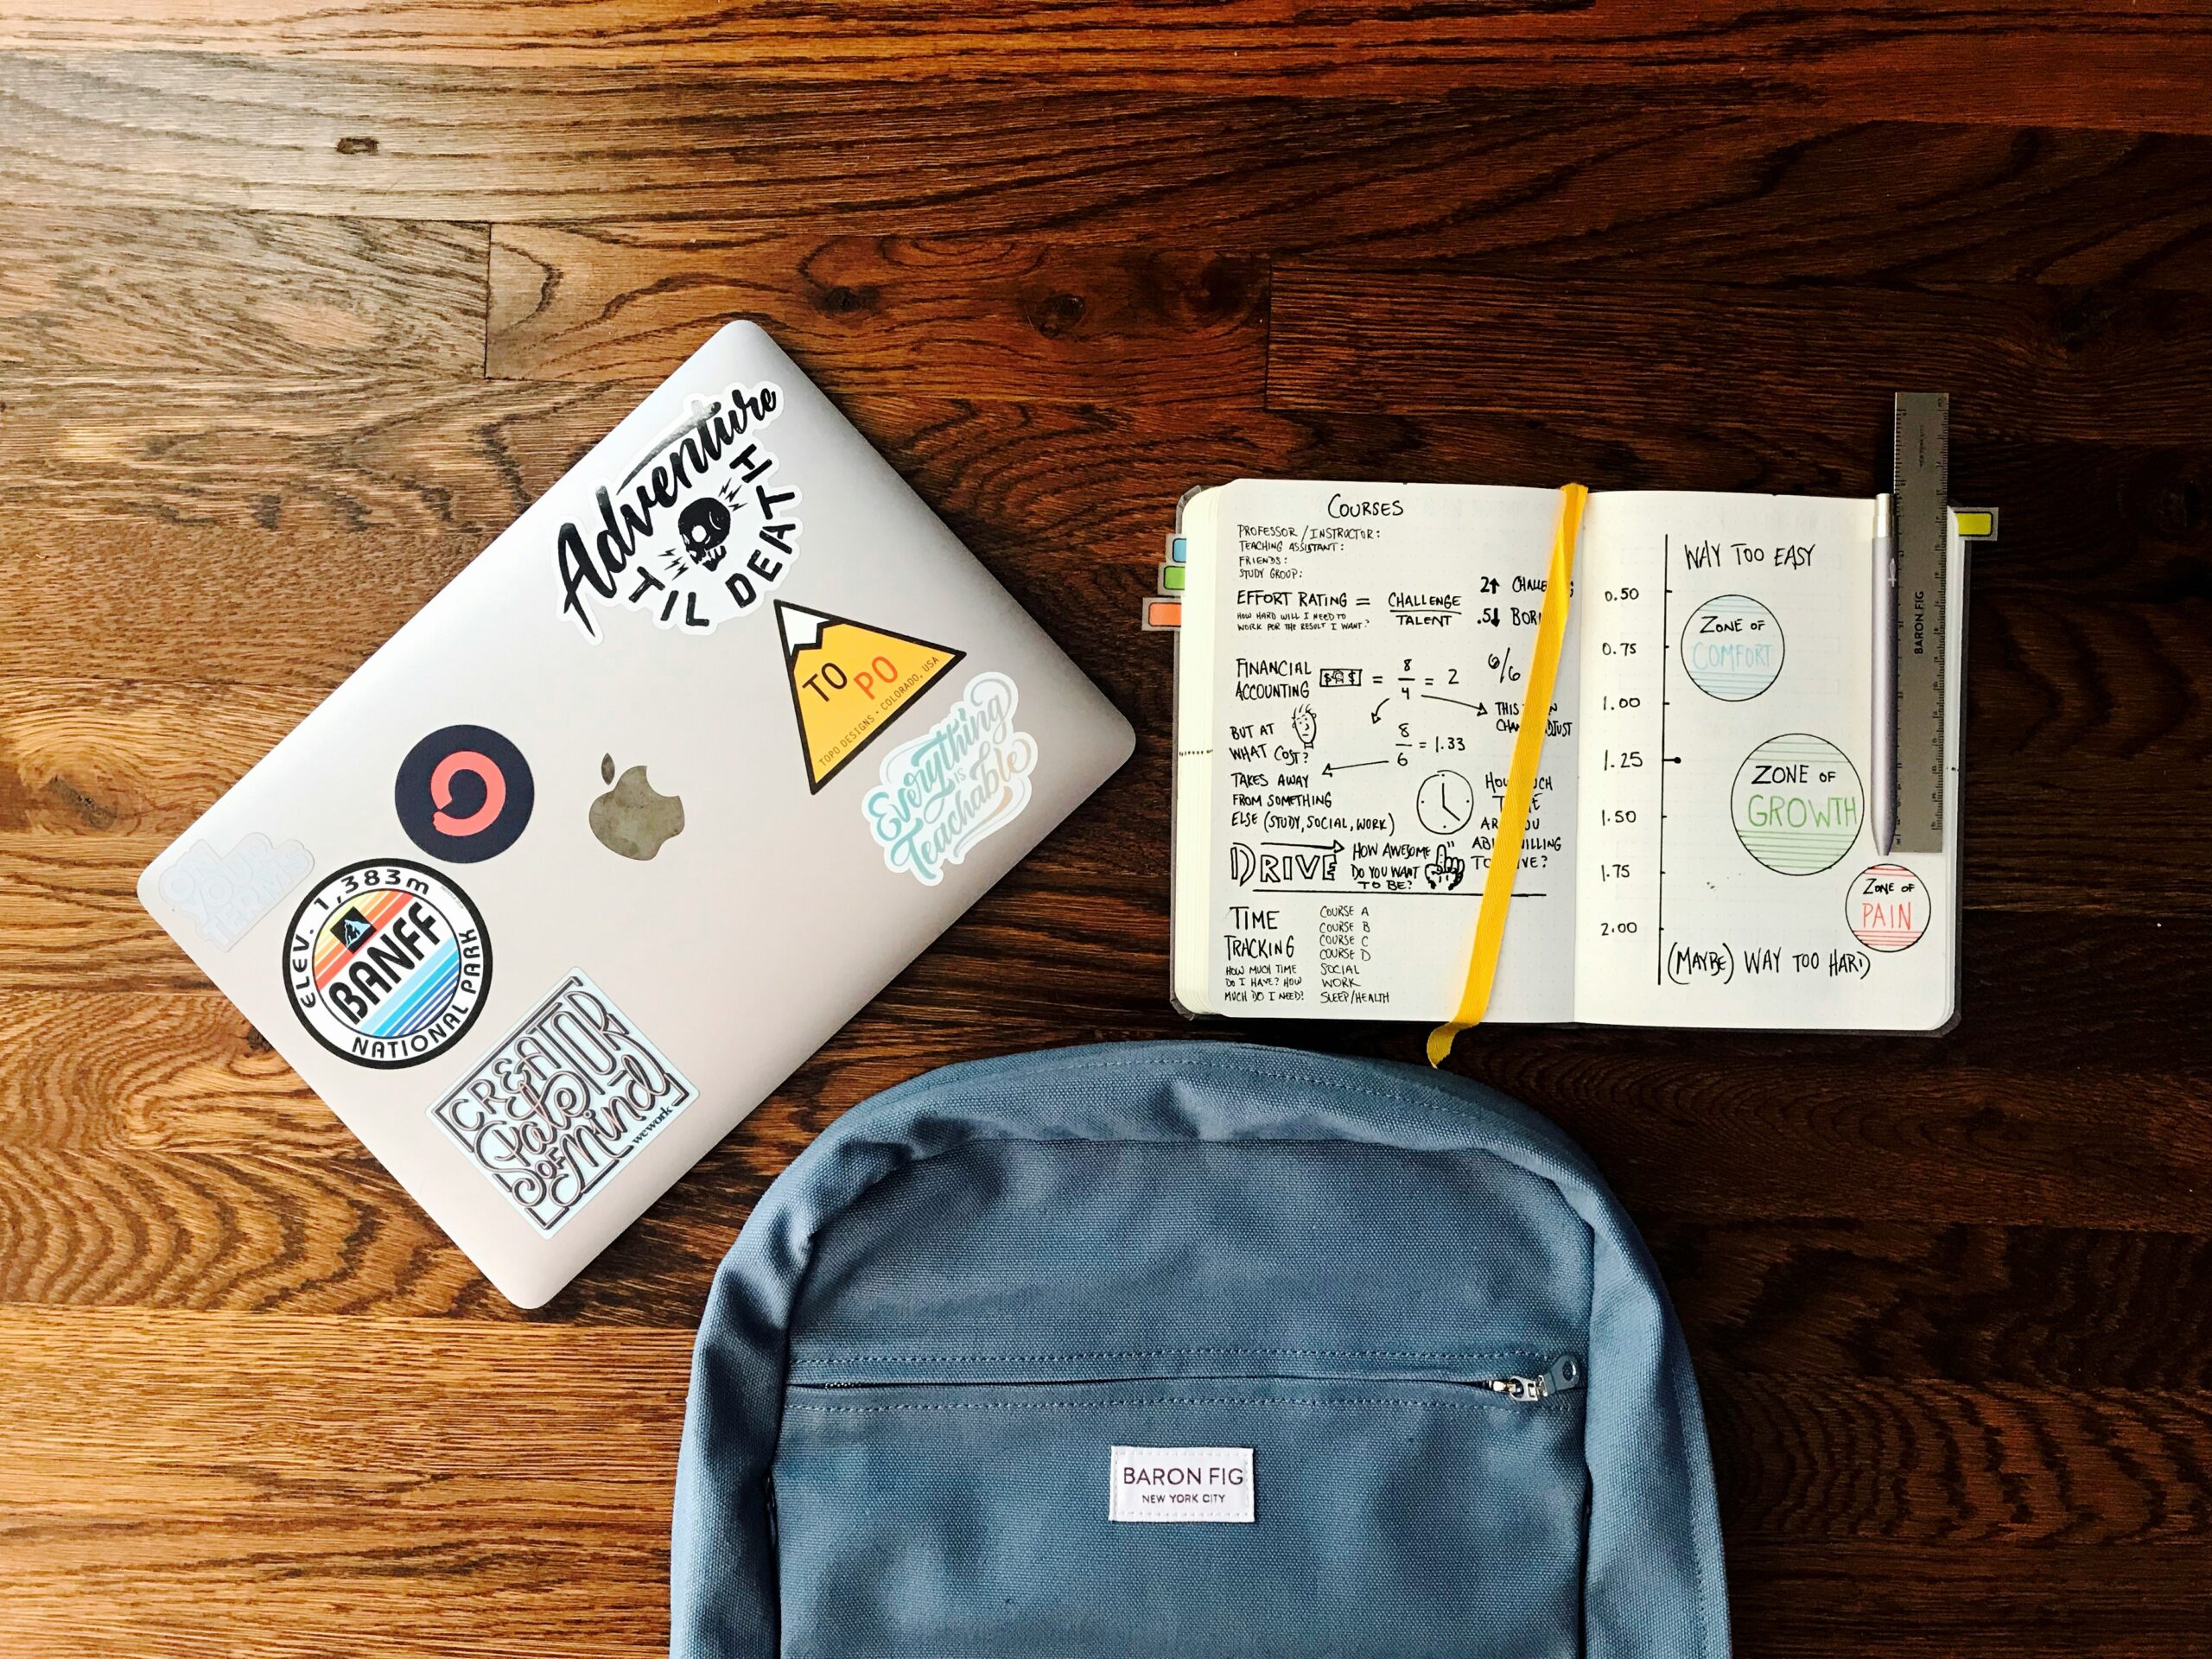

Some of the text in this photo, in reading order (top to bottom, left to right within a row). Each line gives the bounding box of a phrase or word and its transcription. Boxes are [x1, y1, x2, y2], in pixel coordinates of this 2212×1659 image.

[558, 388, 777, 638] Adventure
[1328, 493, 1404, 518] COURSES
[629, 443, 796, 627] TIL DEATH
[1239, 540, 1344, 553] TEACHING ASSISTANT:
[1684, 540, 1816, 570] WAY TOO EASY
[1239, 556, 1287, 566] FRIENDS:
[1239, 569, 1303, 579] STUDY GROUP:
[1237, 590, 1293, 605] EFFORT
[1298, 592, 1347, 607] RATING
[1388, 592, 1462, 609] CHALLENGE
[1605, 588, 1640, 601] 0.50
[1256, 612, 1276, 620] HARD
[1396, 615, 1452, 627] TALENT
[1700, 616, 1766, 633] ZONE OF
[1914, 591, 1924, 654] BARON FIG
[1602, 642, 1637, 657] 0.75
[1692, 641, 1773, 671] COMFORT
[1236, 658, 1312, 678] FINANCIAL
[1448, 669, 1459, 684] 2
[1236, 681, 1310, 702] ACCOUNTING
[819, 747, 841, 766] TOPO
[841, 715, 875, 748] DESIGNS
[921, 656, 939, 672] USA
[1495, 702, 1519, 715] THIS
[1603, 696, 1641, 710] 1.00
[1230, 723, 1274, 741] BUT AT
[1435, 736, 1466, 753] 1.33
[868, 677, 1013, 842] Everything
[1230, 744, 1268, 762] WHAT
[1274, 745, 1309, 766] COST?
[1397, 752, 1408, 766] 6
[1604, 749, 1643, 771] 1.25
[1231, 772, 1309, 788] TAKES AWAY
[1751, 765, 1837, 785] ZONE OF
[1233, 791, 1332, 808] FROM SOMETHING
[890, 739, 1032, 880] Teachable
[1601, 809, 1637, 826] 1.50
[1747, 795, 1857, 828] GROWTH
[1231, 811, 1258, 827] ELSE
[1357, 812, 1395, 836] WORK)
[1353, 842, 1431, 861] HOW AWESOME
[1230, 842, 1338, 887] DRIVE
[1351, 863, 1421, 880] DO YOU WANT
[1601, 865, 1630, 881] 1.75
[1357, 880, 1413, 890] TO BE?
[1863, 878, 1915, 895] ZONE OF
[1229, 906, 1281, 930] TIME
[1319, 906, 1370, 918] COURSE A
[1862, 902, 1911, 931] PAIN
[1319, 921, 1370, 934] COURSE B
[1600, 922, 1637, 935] 2.00
[1224, 935, 1294, 961] TRACKING
[1319, 934, 1369, 947] COURSE C
[328, 901, 441, 1025] BANFF
[1319, 948, 1371, 961] COURSE D
[293, 929, 315, 1008] ELEV.
[1226, 964, 1297, 976] HOW MUCH TIME
[1320, 963, 1360, 975] SOCIAL
[1668, 942, 1734, 985] (MAYBE)
[1744, 947, 1782, 974] WAY
[1793, 952, 1820, 970] TOO
[1225, 976, 1302, 988] DO I HAVE? HOW
[1321, 977, 1361, 988] WORK
[352, 928, 481, 1058] NATIONAL PARK
[1224, 991, 1248, 1001] MUCH
[1251, 990, 1264, 1001] DO
[1268, 991, 1275, 1001] I
[448, 990, 624, 1132] CREATOR
[632, 1106, 672, 1144] wework
[1124, 1467, 1243, 1484] BARON FIG
[1142, 1494, 1225, 1503] NEW YORK CITY
